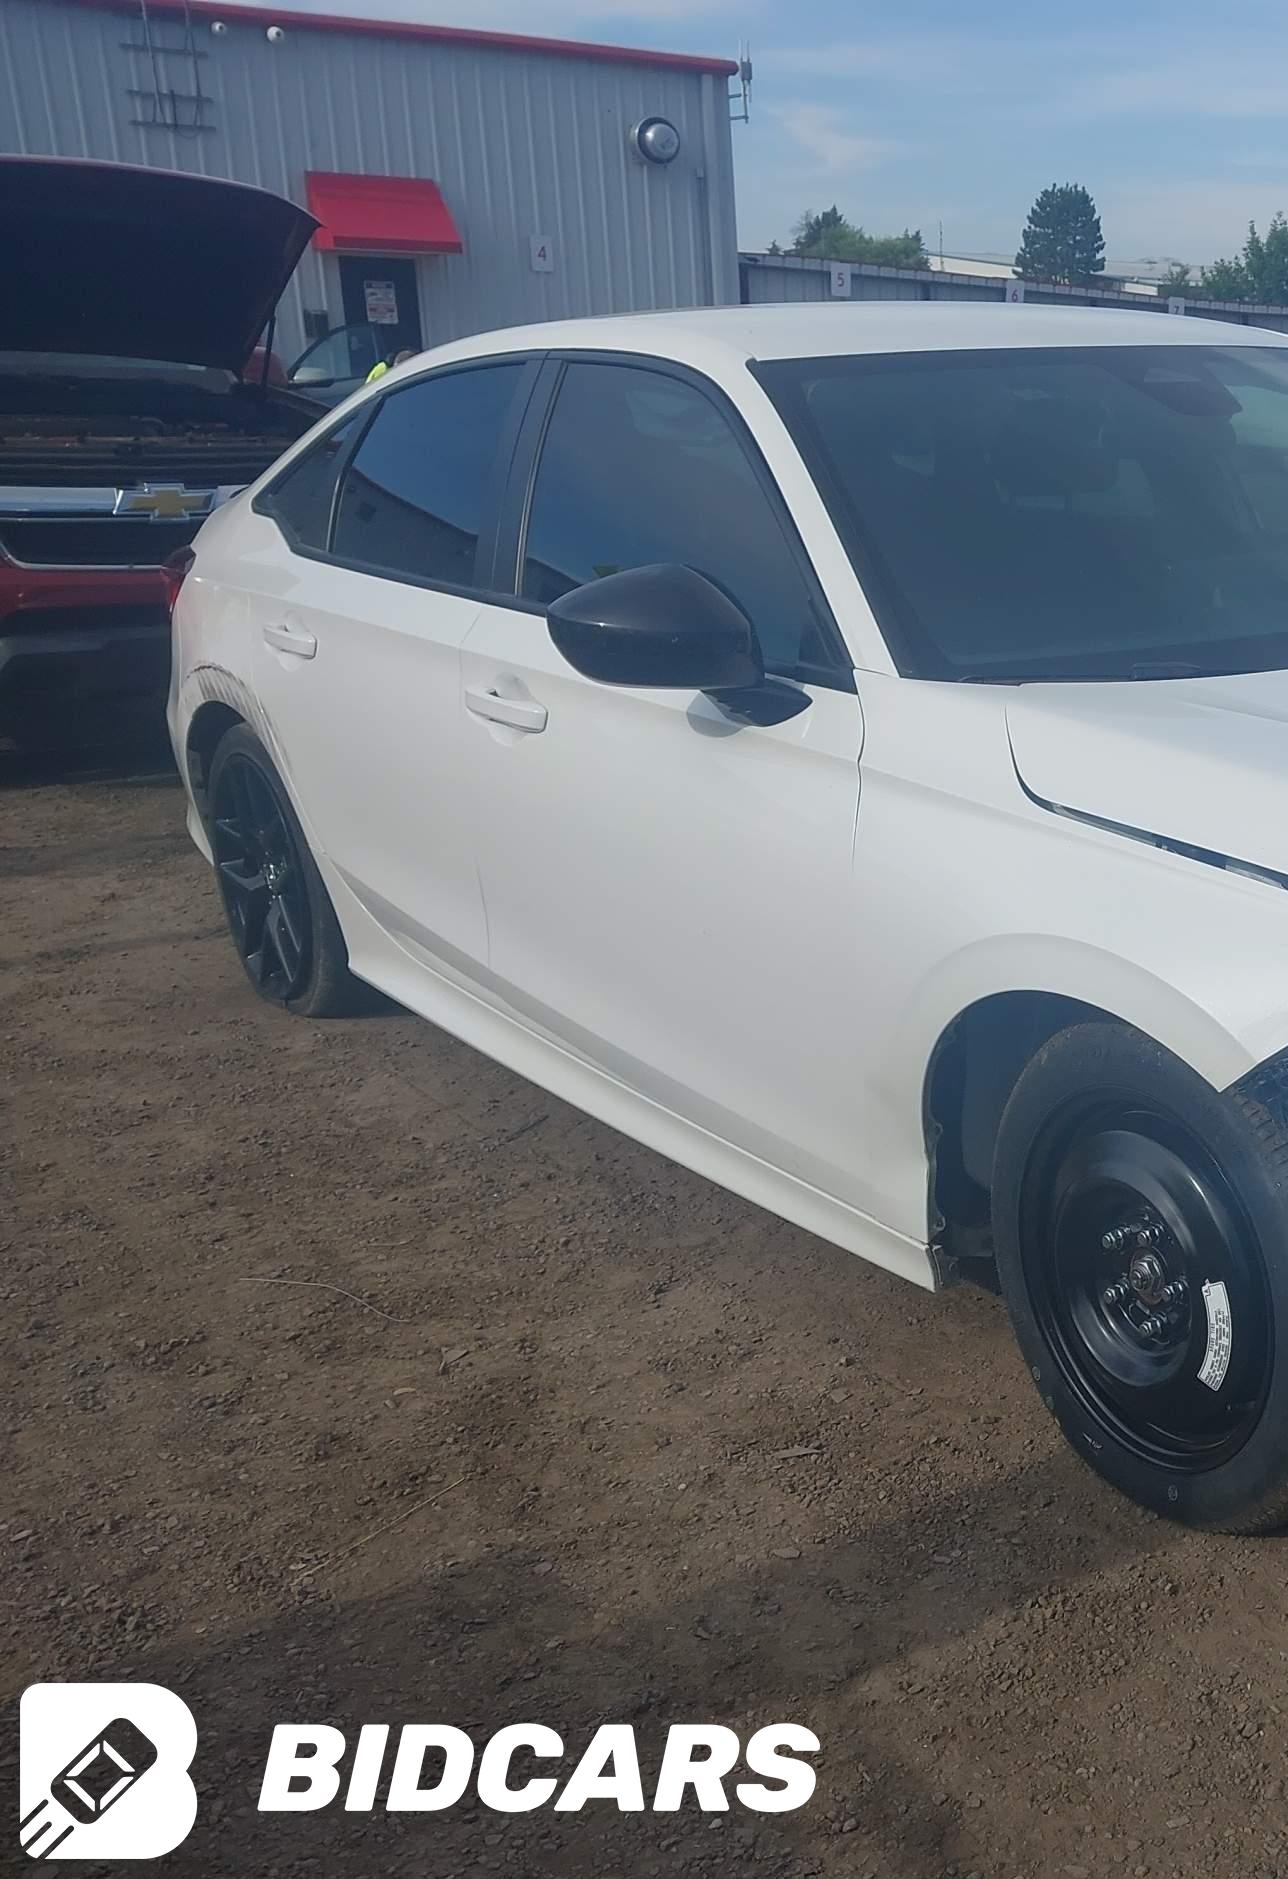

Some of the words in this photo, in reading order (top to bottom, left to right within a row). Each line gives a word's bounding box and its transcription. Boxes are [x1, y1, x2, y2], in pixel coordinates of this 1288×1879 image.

[538, 245, 546, 261] 4
[837, 272, 845, 287] 5
[1011, 288, 1018, 302] 6
